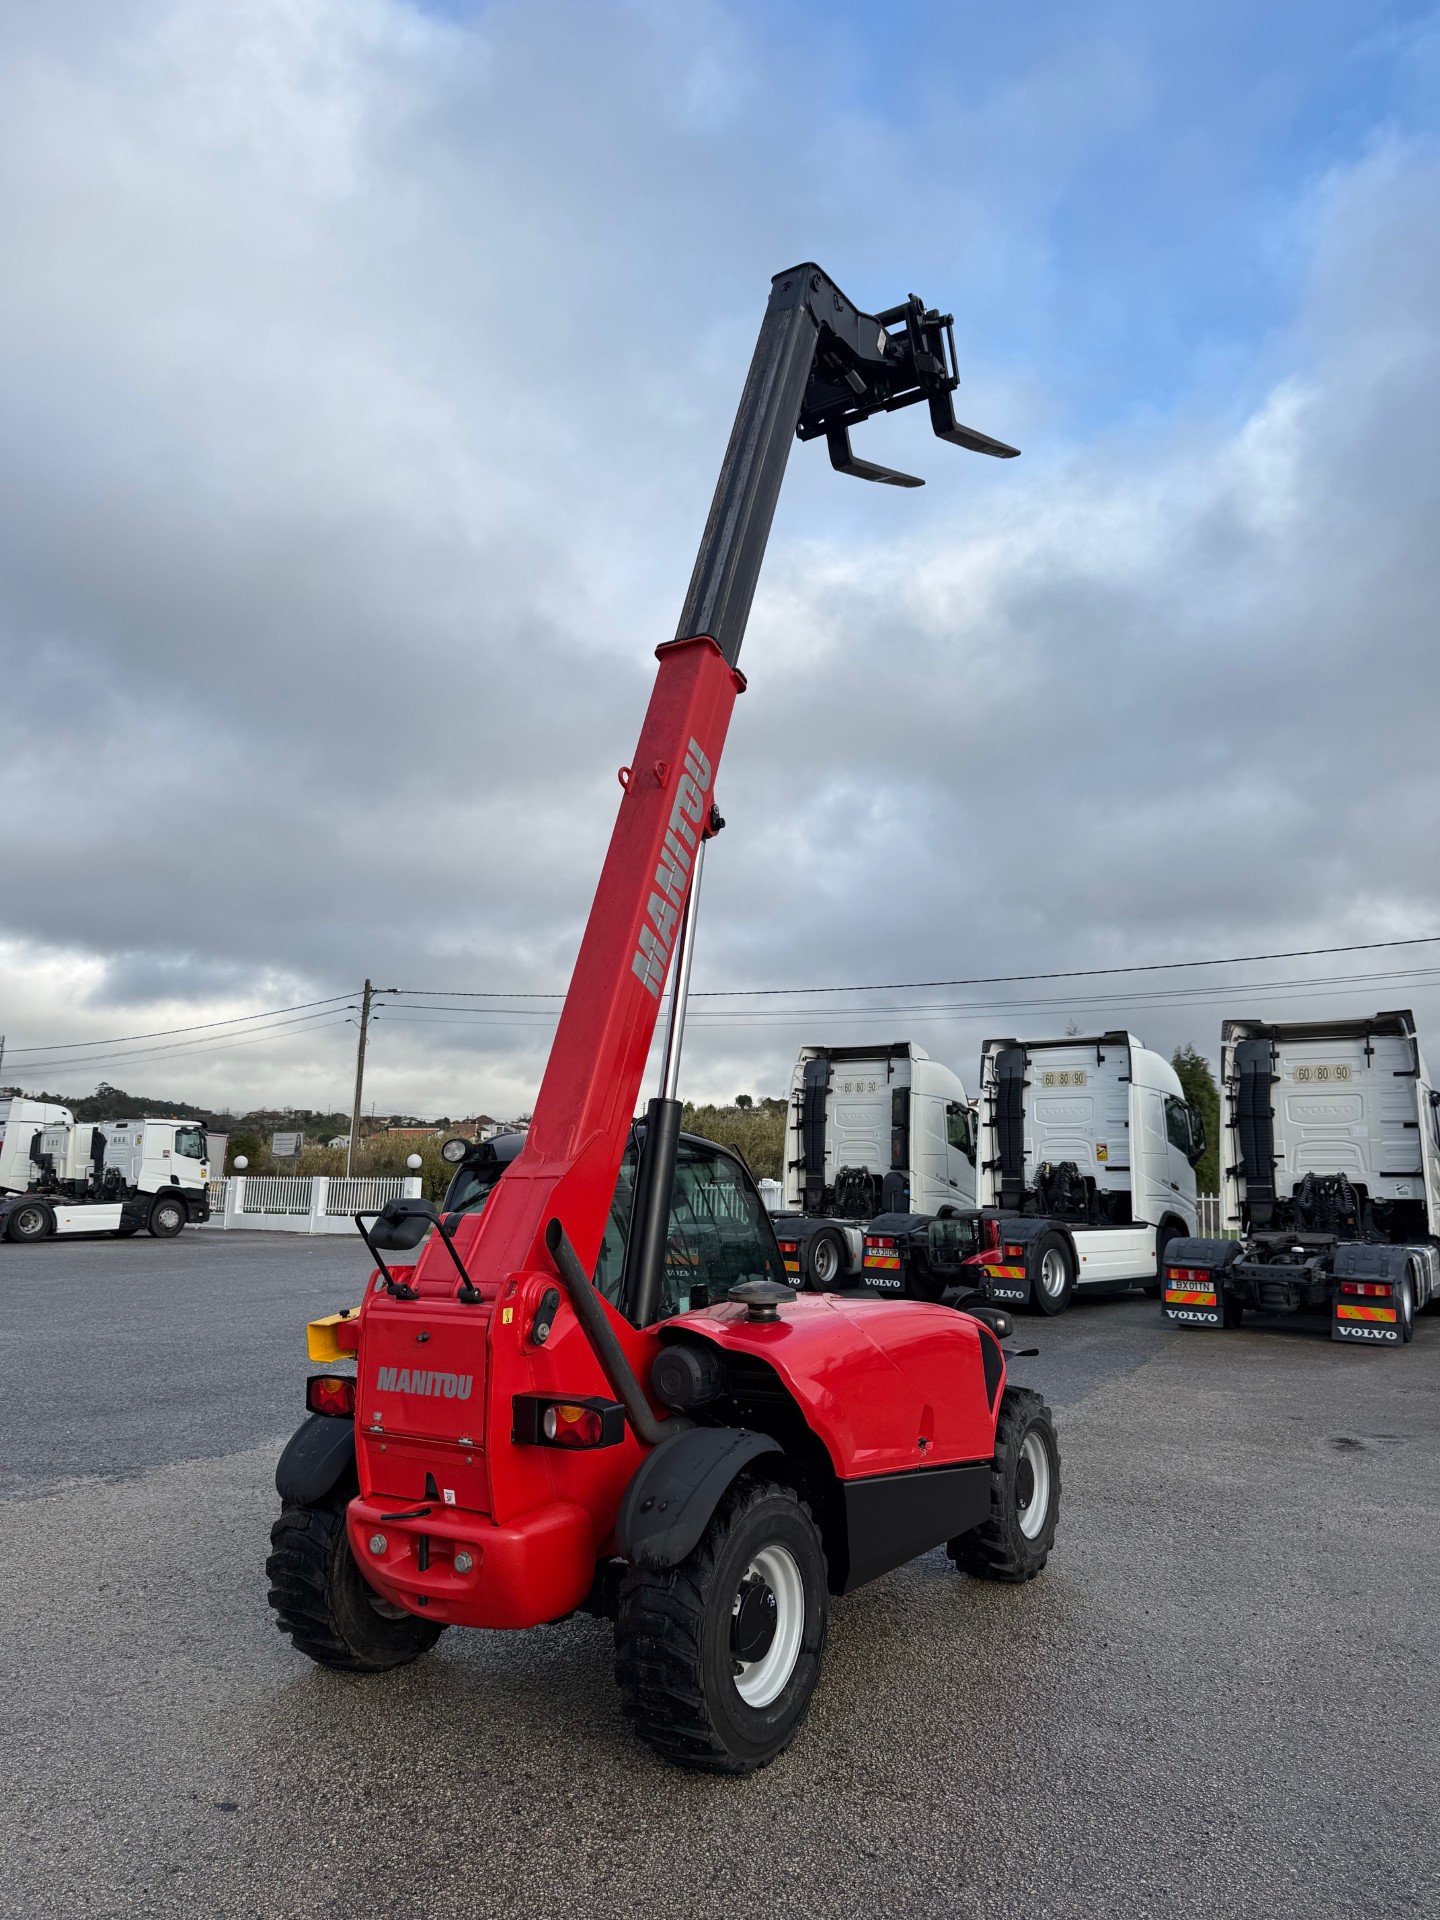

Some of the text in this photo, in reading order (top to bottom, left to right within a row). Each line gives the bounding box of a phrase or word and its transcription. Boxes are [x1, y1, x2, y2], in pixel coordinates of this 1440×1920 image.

[631, 736, 711, 1000] MANITOU
[1045, 1073, 1083, 1085] 60 80 90
[1298, 1066, 1347, 1080] 60 80 90
[864, 1278, 900, 1288] VOLVO
[994, 1288, 1025, 1299] OLVO
[1166, 1309, 1218, 1322] VOLVO
[1337, 1326, 1398, 1340] VOLVO
[376, 1366, 474, 1400] MANITOU
